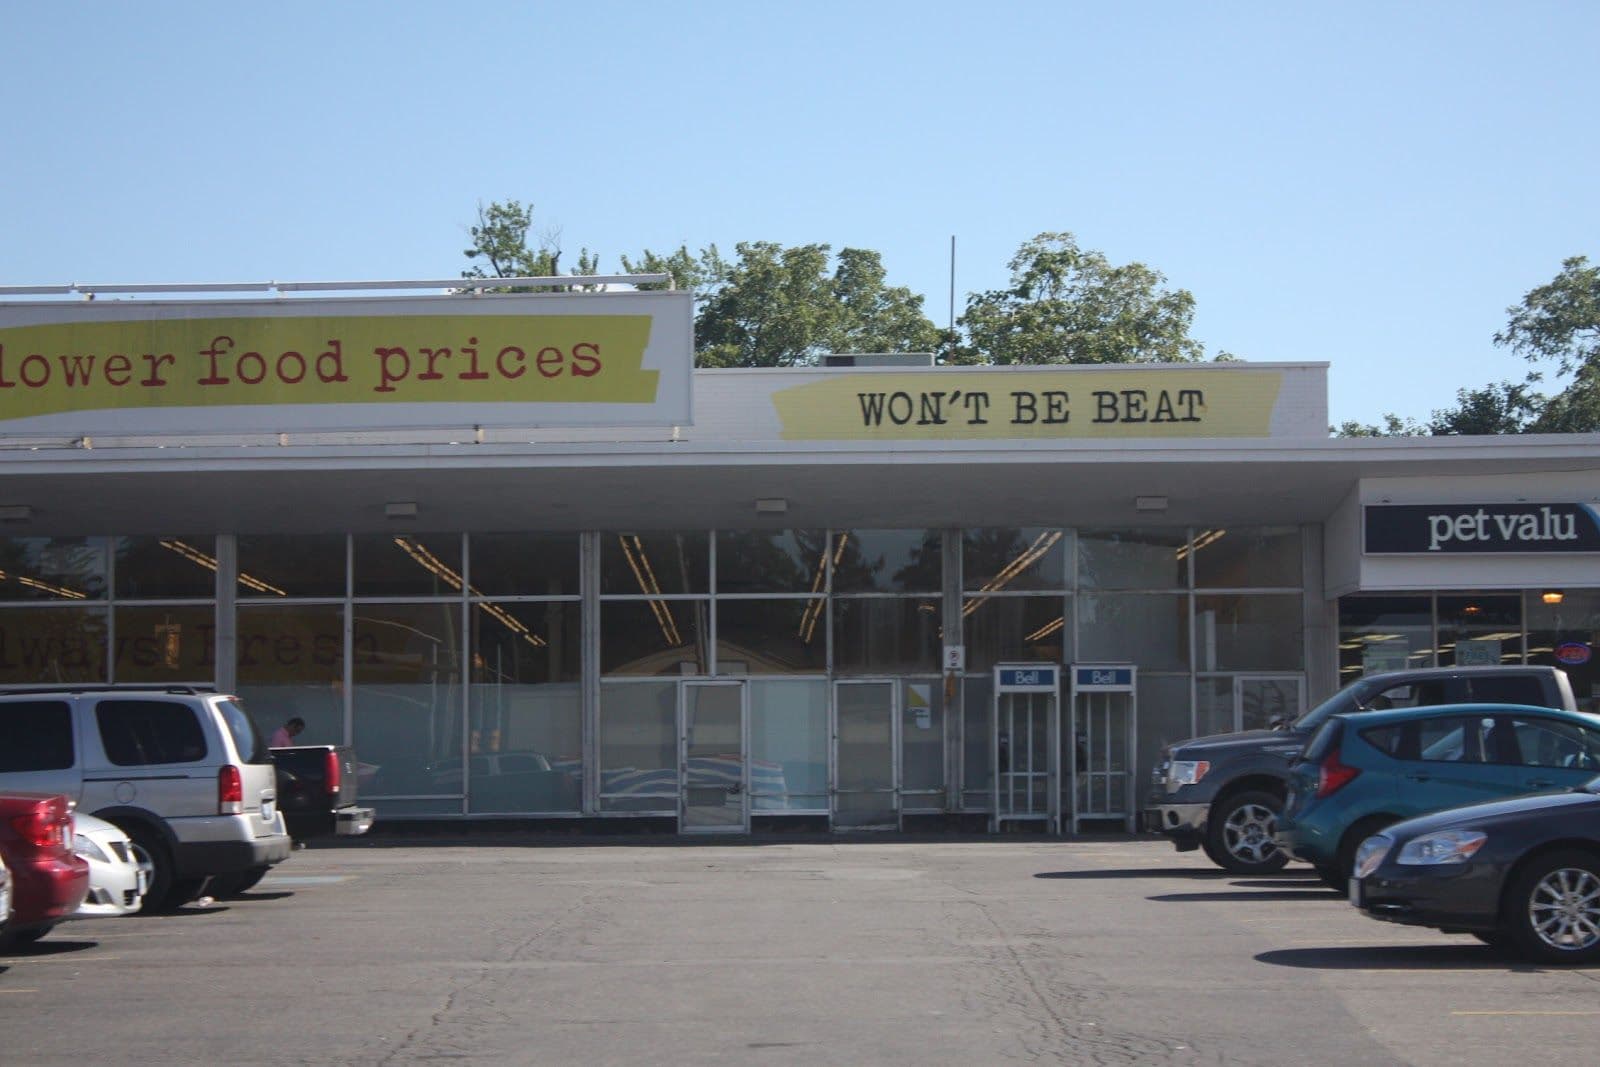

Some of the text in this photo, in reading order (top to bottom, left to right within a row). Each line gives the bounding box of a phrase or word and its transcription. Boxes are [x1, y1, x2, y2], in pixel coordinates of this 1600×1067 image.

[0, 336, 602, 393] lower food prices
[857, 389, 1204, 427] WON'T BE BEAT
[1427, 507, 1578, 550] pet valu
[1014, 671, 1039, 685] Bell
[1091, 670, 1116, 685] Bell
